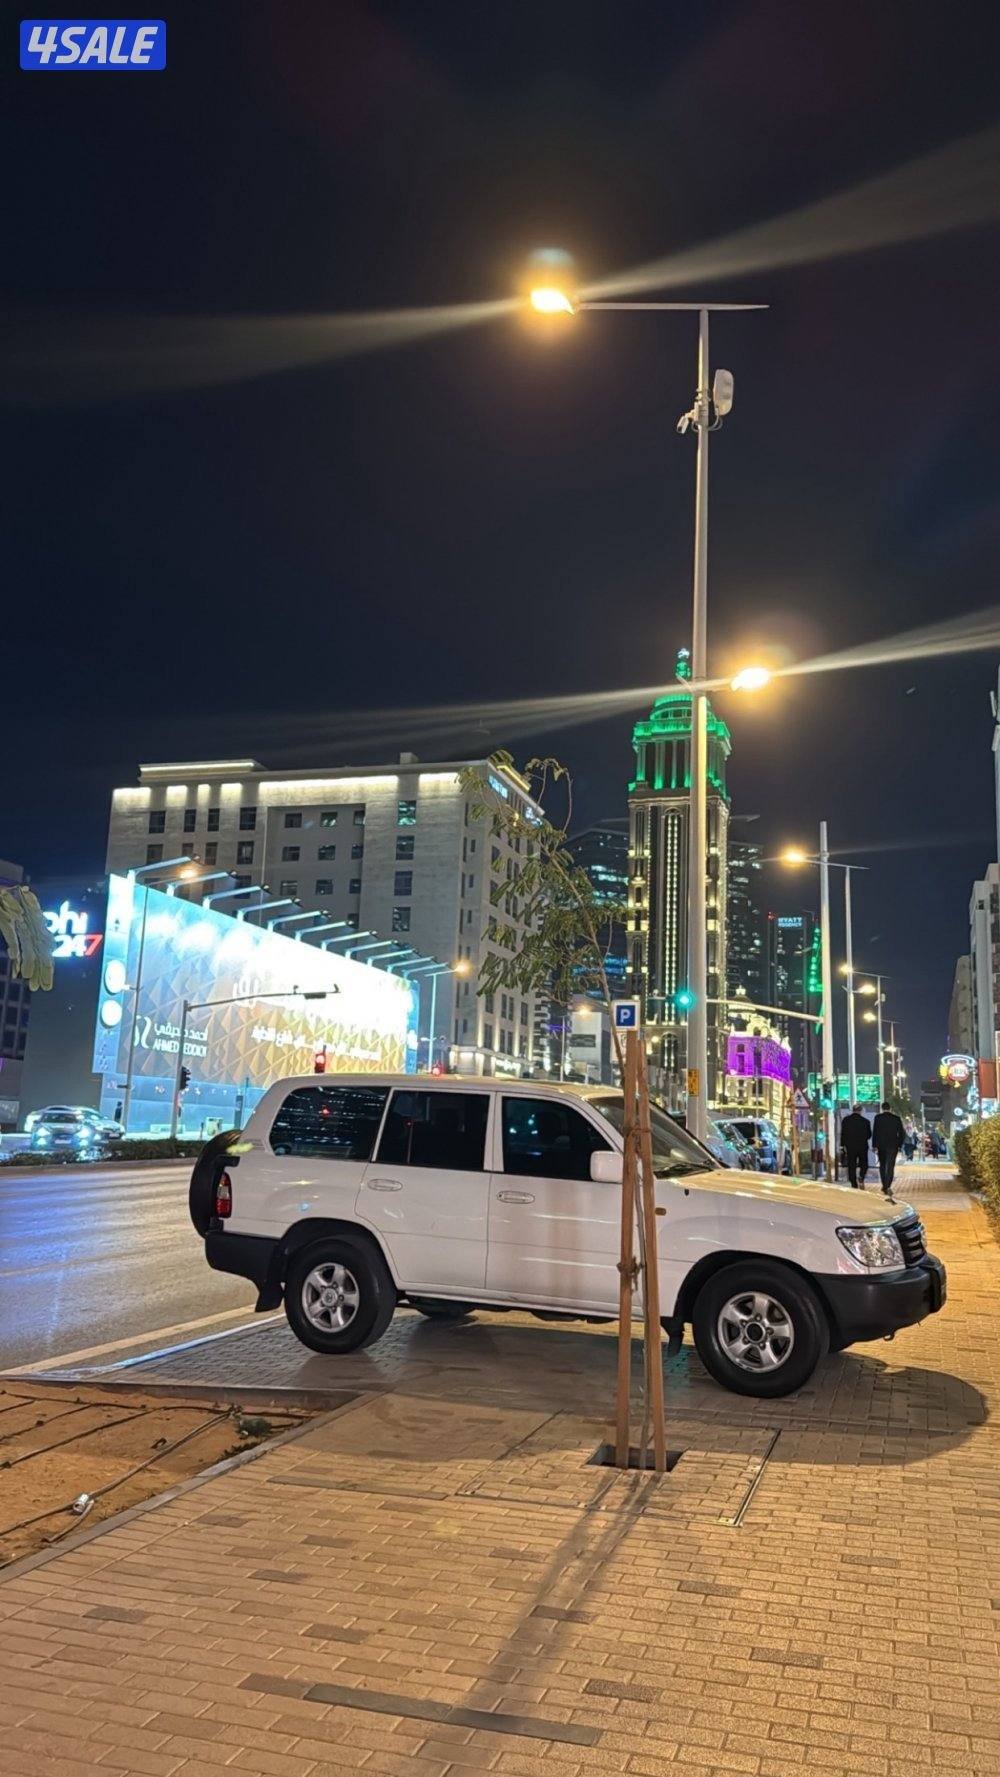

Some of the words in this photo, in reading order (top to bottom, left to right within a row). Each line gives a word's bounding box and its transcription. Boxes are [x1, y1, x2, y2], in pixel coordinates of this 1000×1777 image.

[52, 934, 103, 957] 247
[620, 1008, 631, 1023] P
[152, 1038, 180, 1053] AHMED
